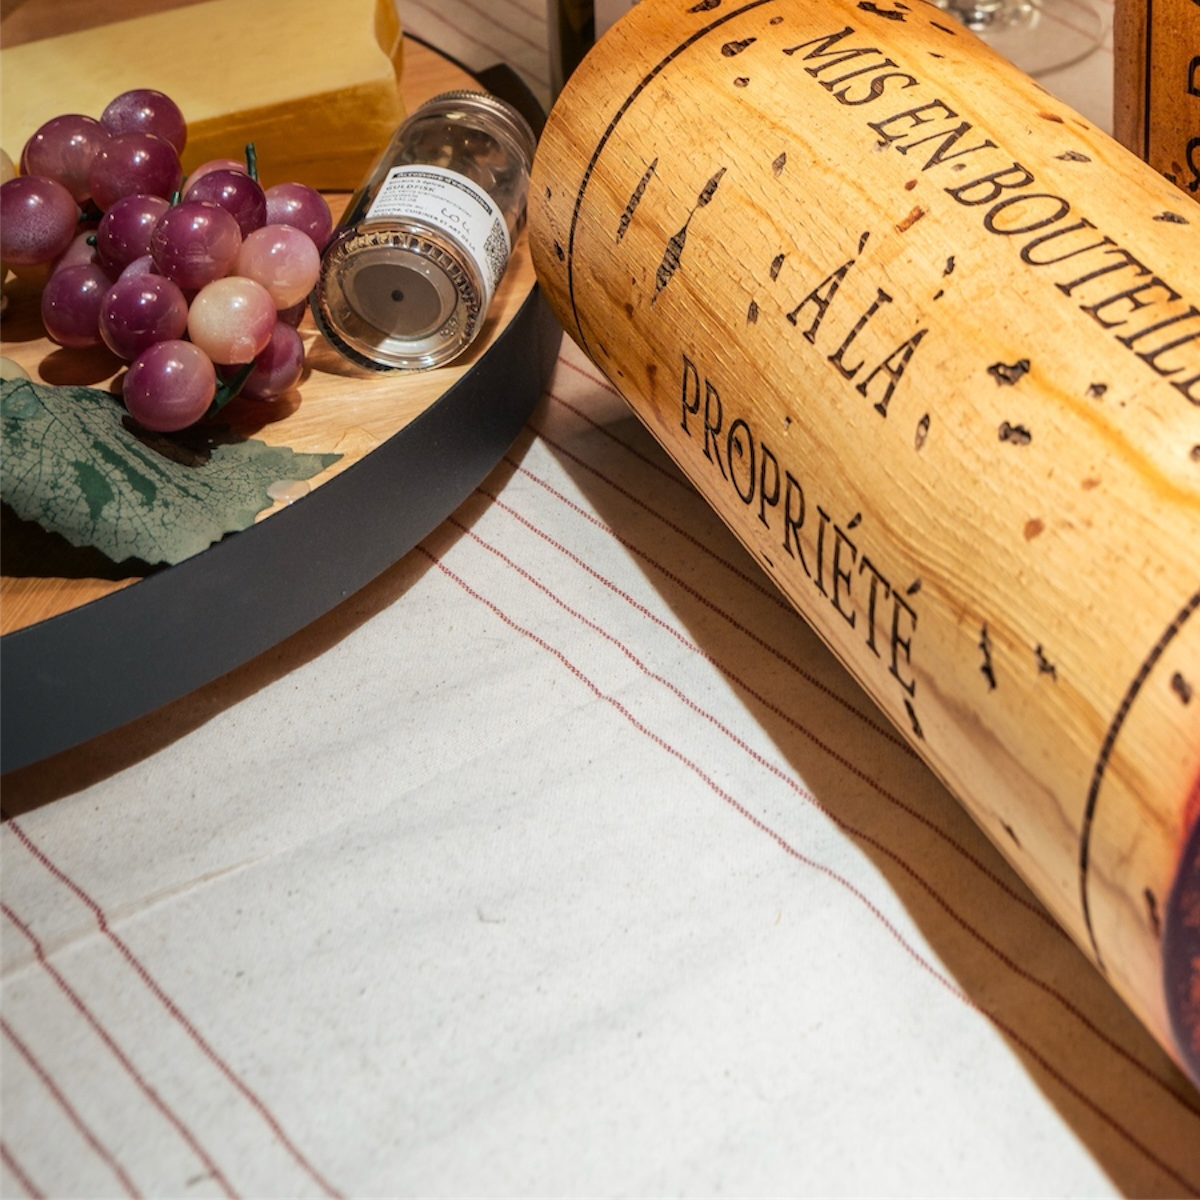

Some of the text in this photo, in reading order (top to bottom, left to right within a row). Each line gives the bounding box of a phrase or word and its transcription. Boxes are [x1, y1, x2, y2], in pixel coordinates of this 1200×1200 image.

[783, 25, 919, 106] MIS
[868, 99, 997, 172] EN
[828, 287, 930, 419] LA
[678, 353, 924, 698] PROPRIÉTÉ
